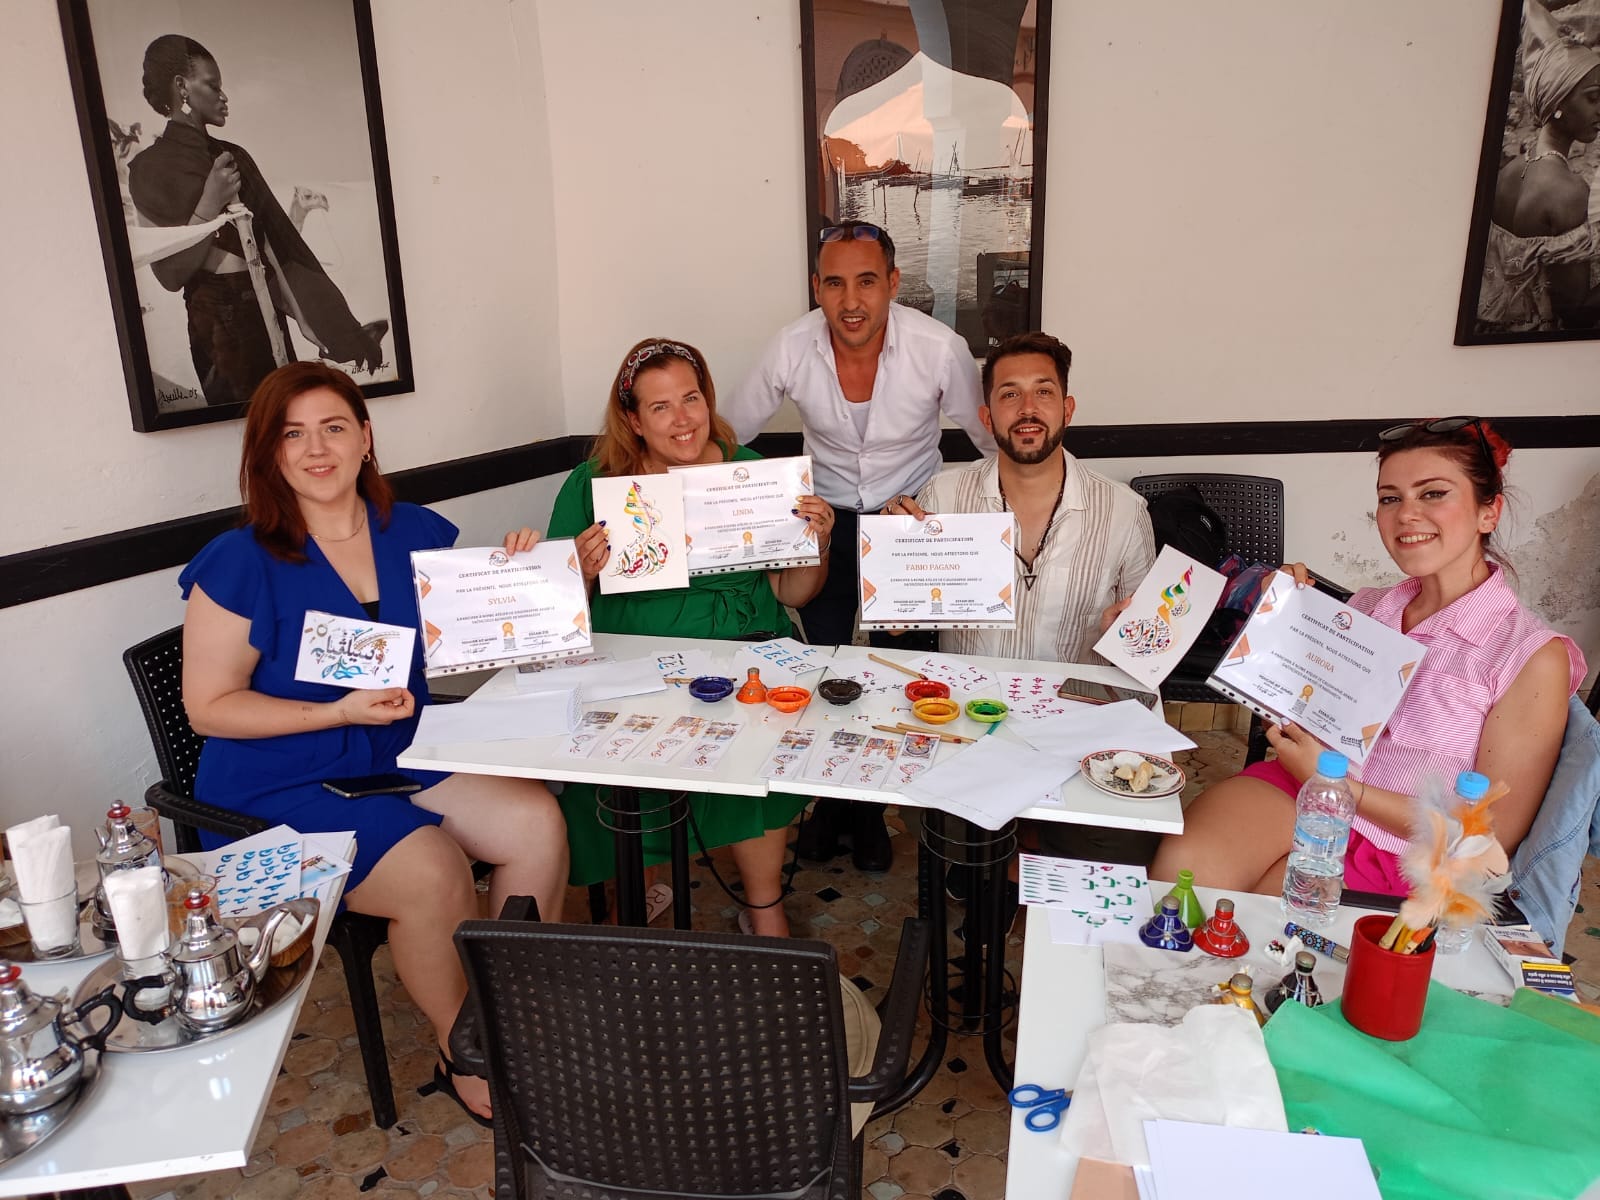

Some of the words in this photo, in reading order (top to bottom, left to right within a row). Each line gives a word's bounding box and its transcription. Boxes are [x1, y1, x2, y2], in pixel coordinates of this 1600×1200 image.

[733, 508, 754, 516] LINDA
[488, 596, 517, 605] SYLVIA
[1301, 613, 1329, 631] CERTIFICAT
[1336, 632, 1374, 655] PARTICIPATION
[1305, 651, 1336, 672] AURORA
